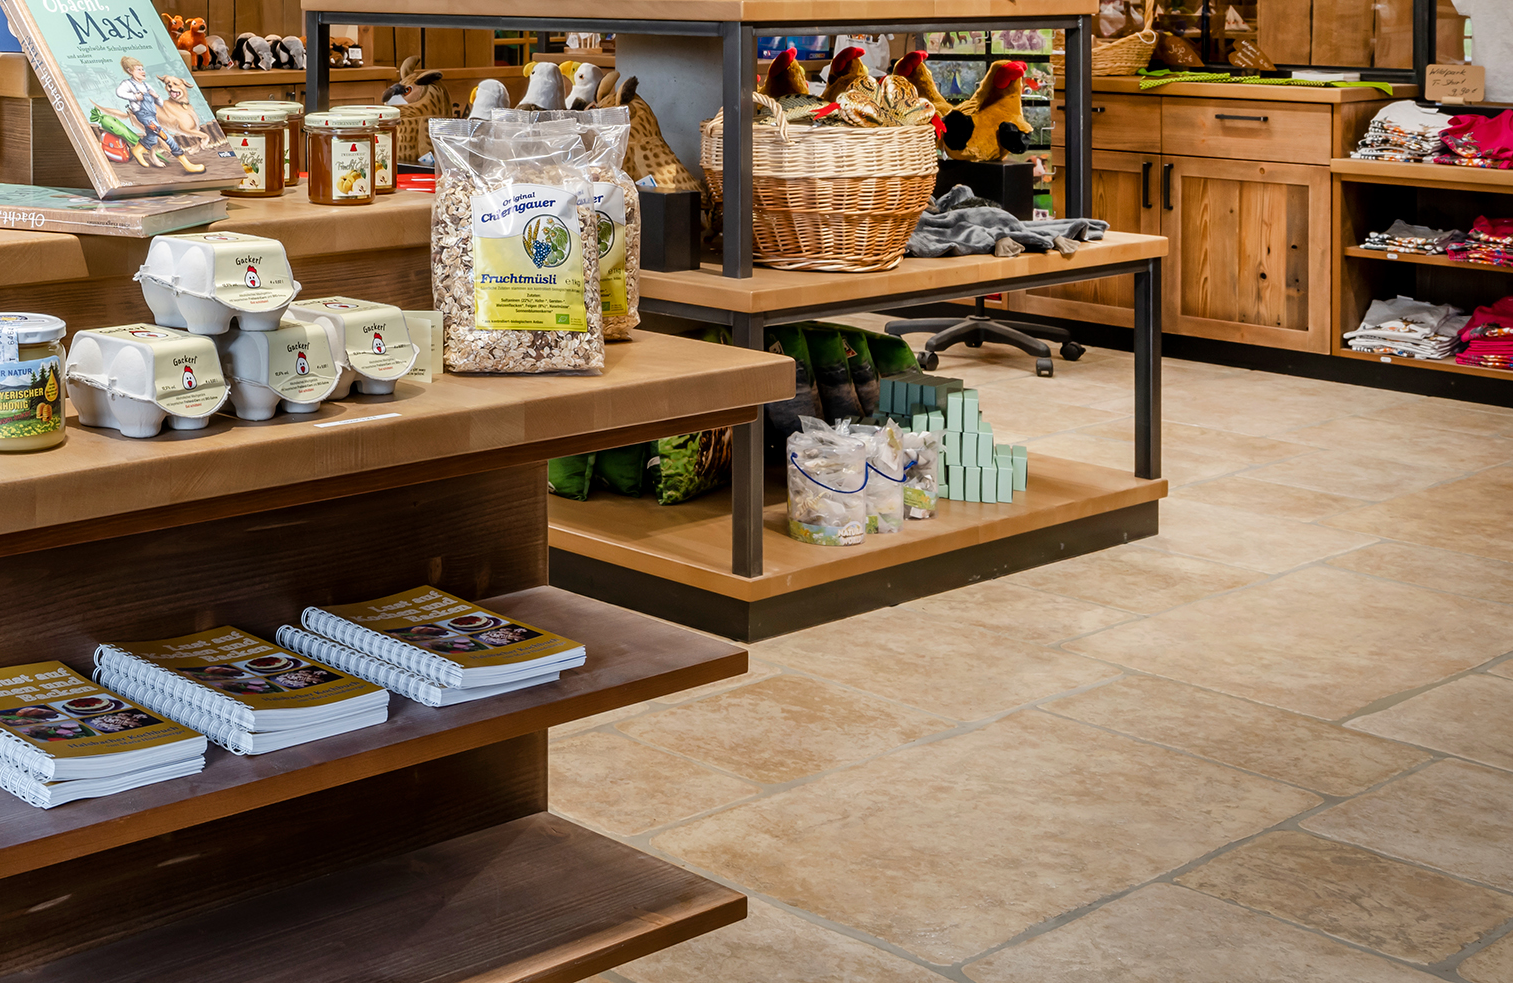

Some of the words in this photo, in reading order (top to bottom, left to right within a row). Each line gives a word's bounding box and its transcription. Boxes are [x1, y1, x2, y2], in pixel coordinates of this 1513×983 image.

[66, 7, 148, 45] Max!
[77, 46, 106, 54] Vogelwilde
[106, 44, 154, 52] Schulgeschichten
[1429, 68, 1466, 77] Wildpark
[502, 192, 536, 206] Original
[481, 198, 556, 223] Chiemgauer
[235, 254, 262, 266] Gackerl
[480, 274, 557, 285] Fruchtmüsli
[571, 280, 580, 288] 1kg
[362, 323, 386, 334] Gackerl
[286, 342, 310, 353] Gackerl
[172, 355, 198, 366] Gackerl
[8, 368, 33, 376] NATUR
[0, 416, 13, 424] vom
[352, 608, 417, 623] Kochen
[418, 596, 458, 612] und
[367, 600, 412, 614] Lust
[412, 589, 444, 604] auf
[402, 604, 472, 623] Backen
[140, 646, 216, 660] Kochen
[218, 638, 260, 651] und
[162, 639, 212, 652] Lust
[213, 630, 244, 645] auf
[198, 644, 274, 662] Backen
[34, 667, 71, 683] auf
[39, 676, 84, 692] und
[16, 685, 98, 704] Backen
[128, 724, 180, 741] Kochbuch
